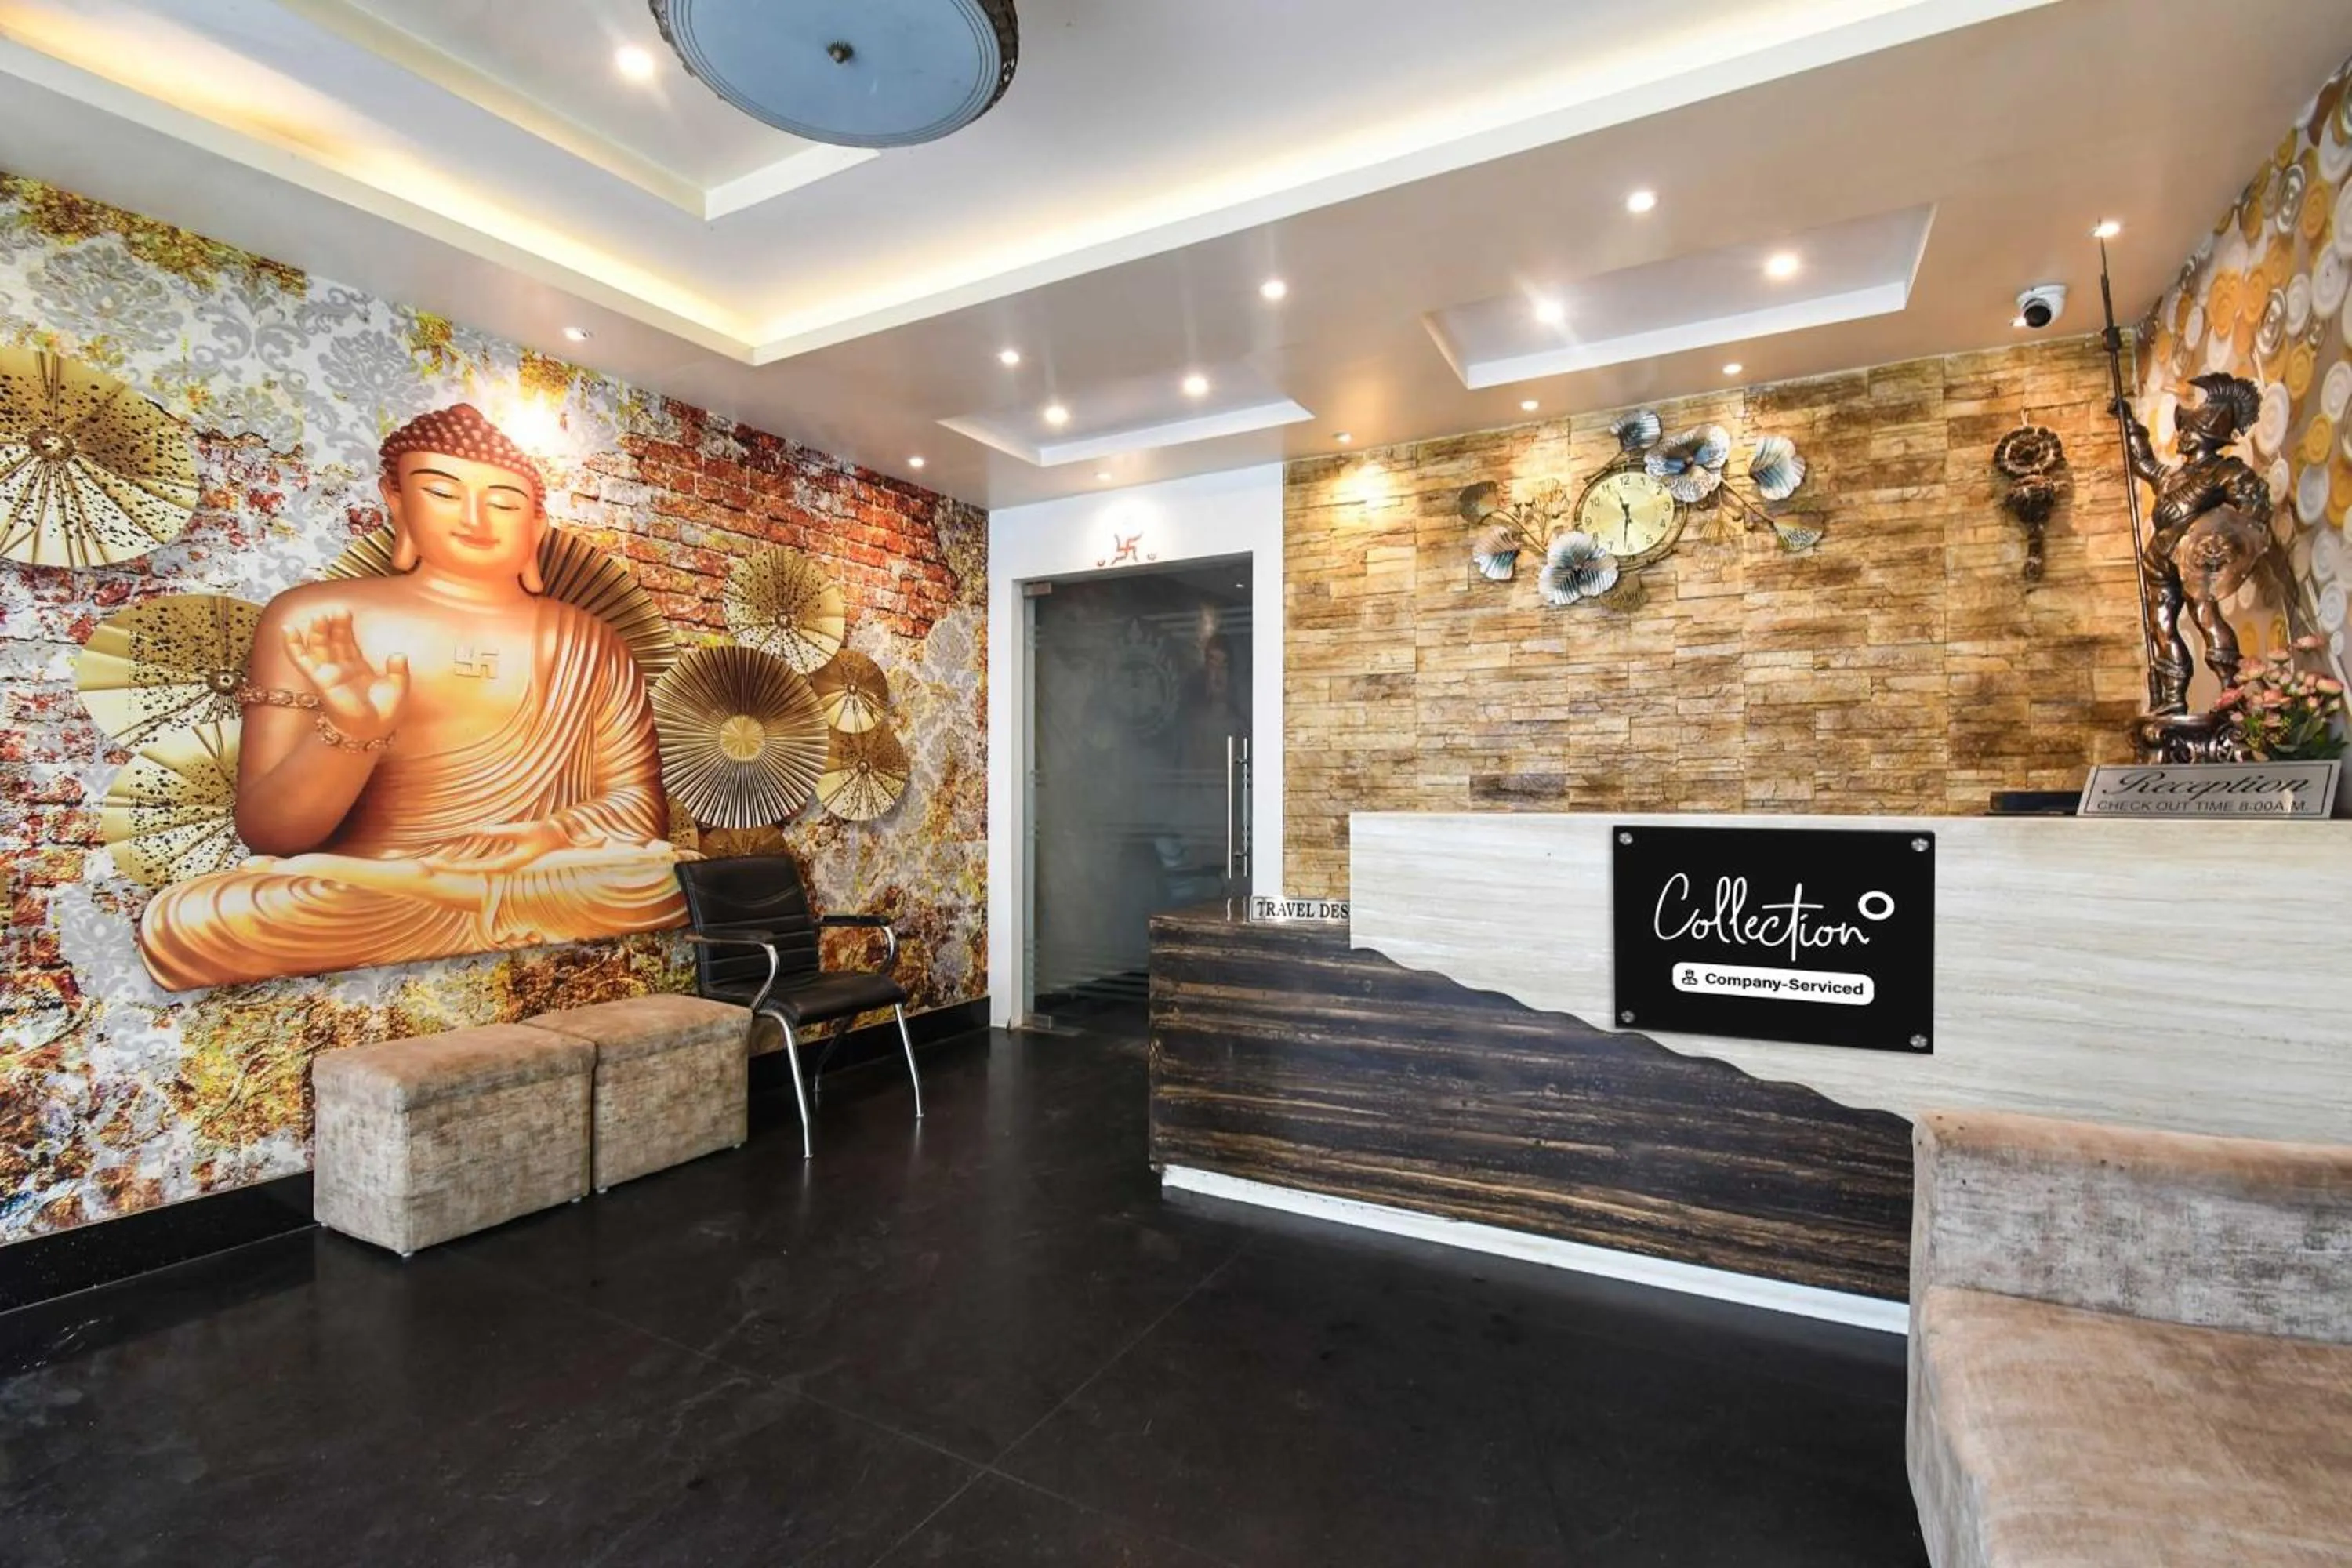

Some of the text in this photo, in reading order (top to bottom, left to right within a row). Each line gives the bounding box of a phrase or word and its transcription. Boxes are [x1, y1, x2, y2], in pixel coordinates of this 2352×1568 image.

[1620, 475, 1630, 486] 12
[1640, 477, 1646, 485] 1
[1602, 483, 1610, 493] 11
[1656, 485, 1663, 495] 2
[1590, 496, 1600, 508] 10
[1664, 502, 1671, 512] 3
[1584, 517, 1592, 527] 9
[1660, 517, 1666, 528] 4
[1646, 534, 1653, 544] 5
[1608, 540, 1614, 550] 7
[1627, 543, 1635, 553] 6
[2102, 771, 2310, 801] Reception
[2097, 800, 2153, 811] CHECK
[2156, 800, 2190, 811] OUT
[2196, 800, 2233, 811] TIME
[1257, 902, 1350, 919] TRAVEL DES
[1654, 873, 1870, 962] Collection
[1704, 972, 1864, 996] Company-Serviced
